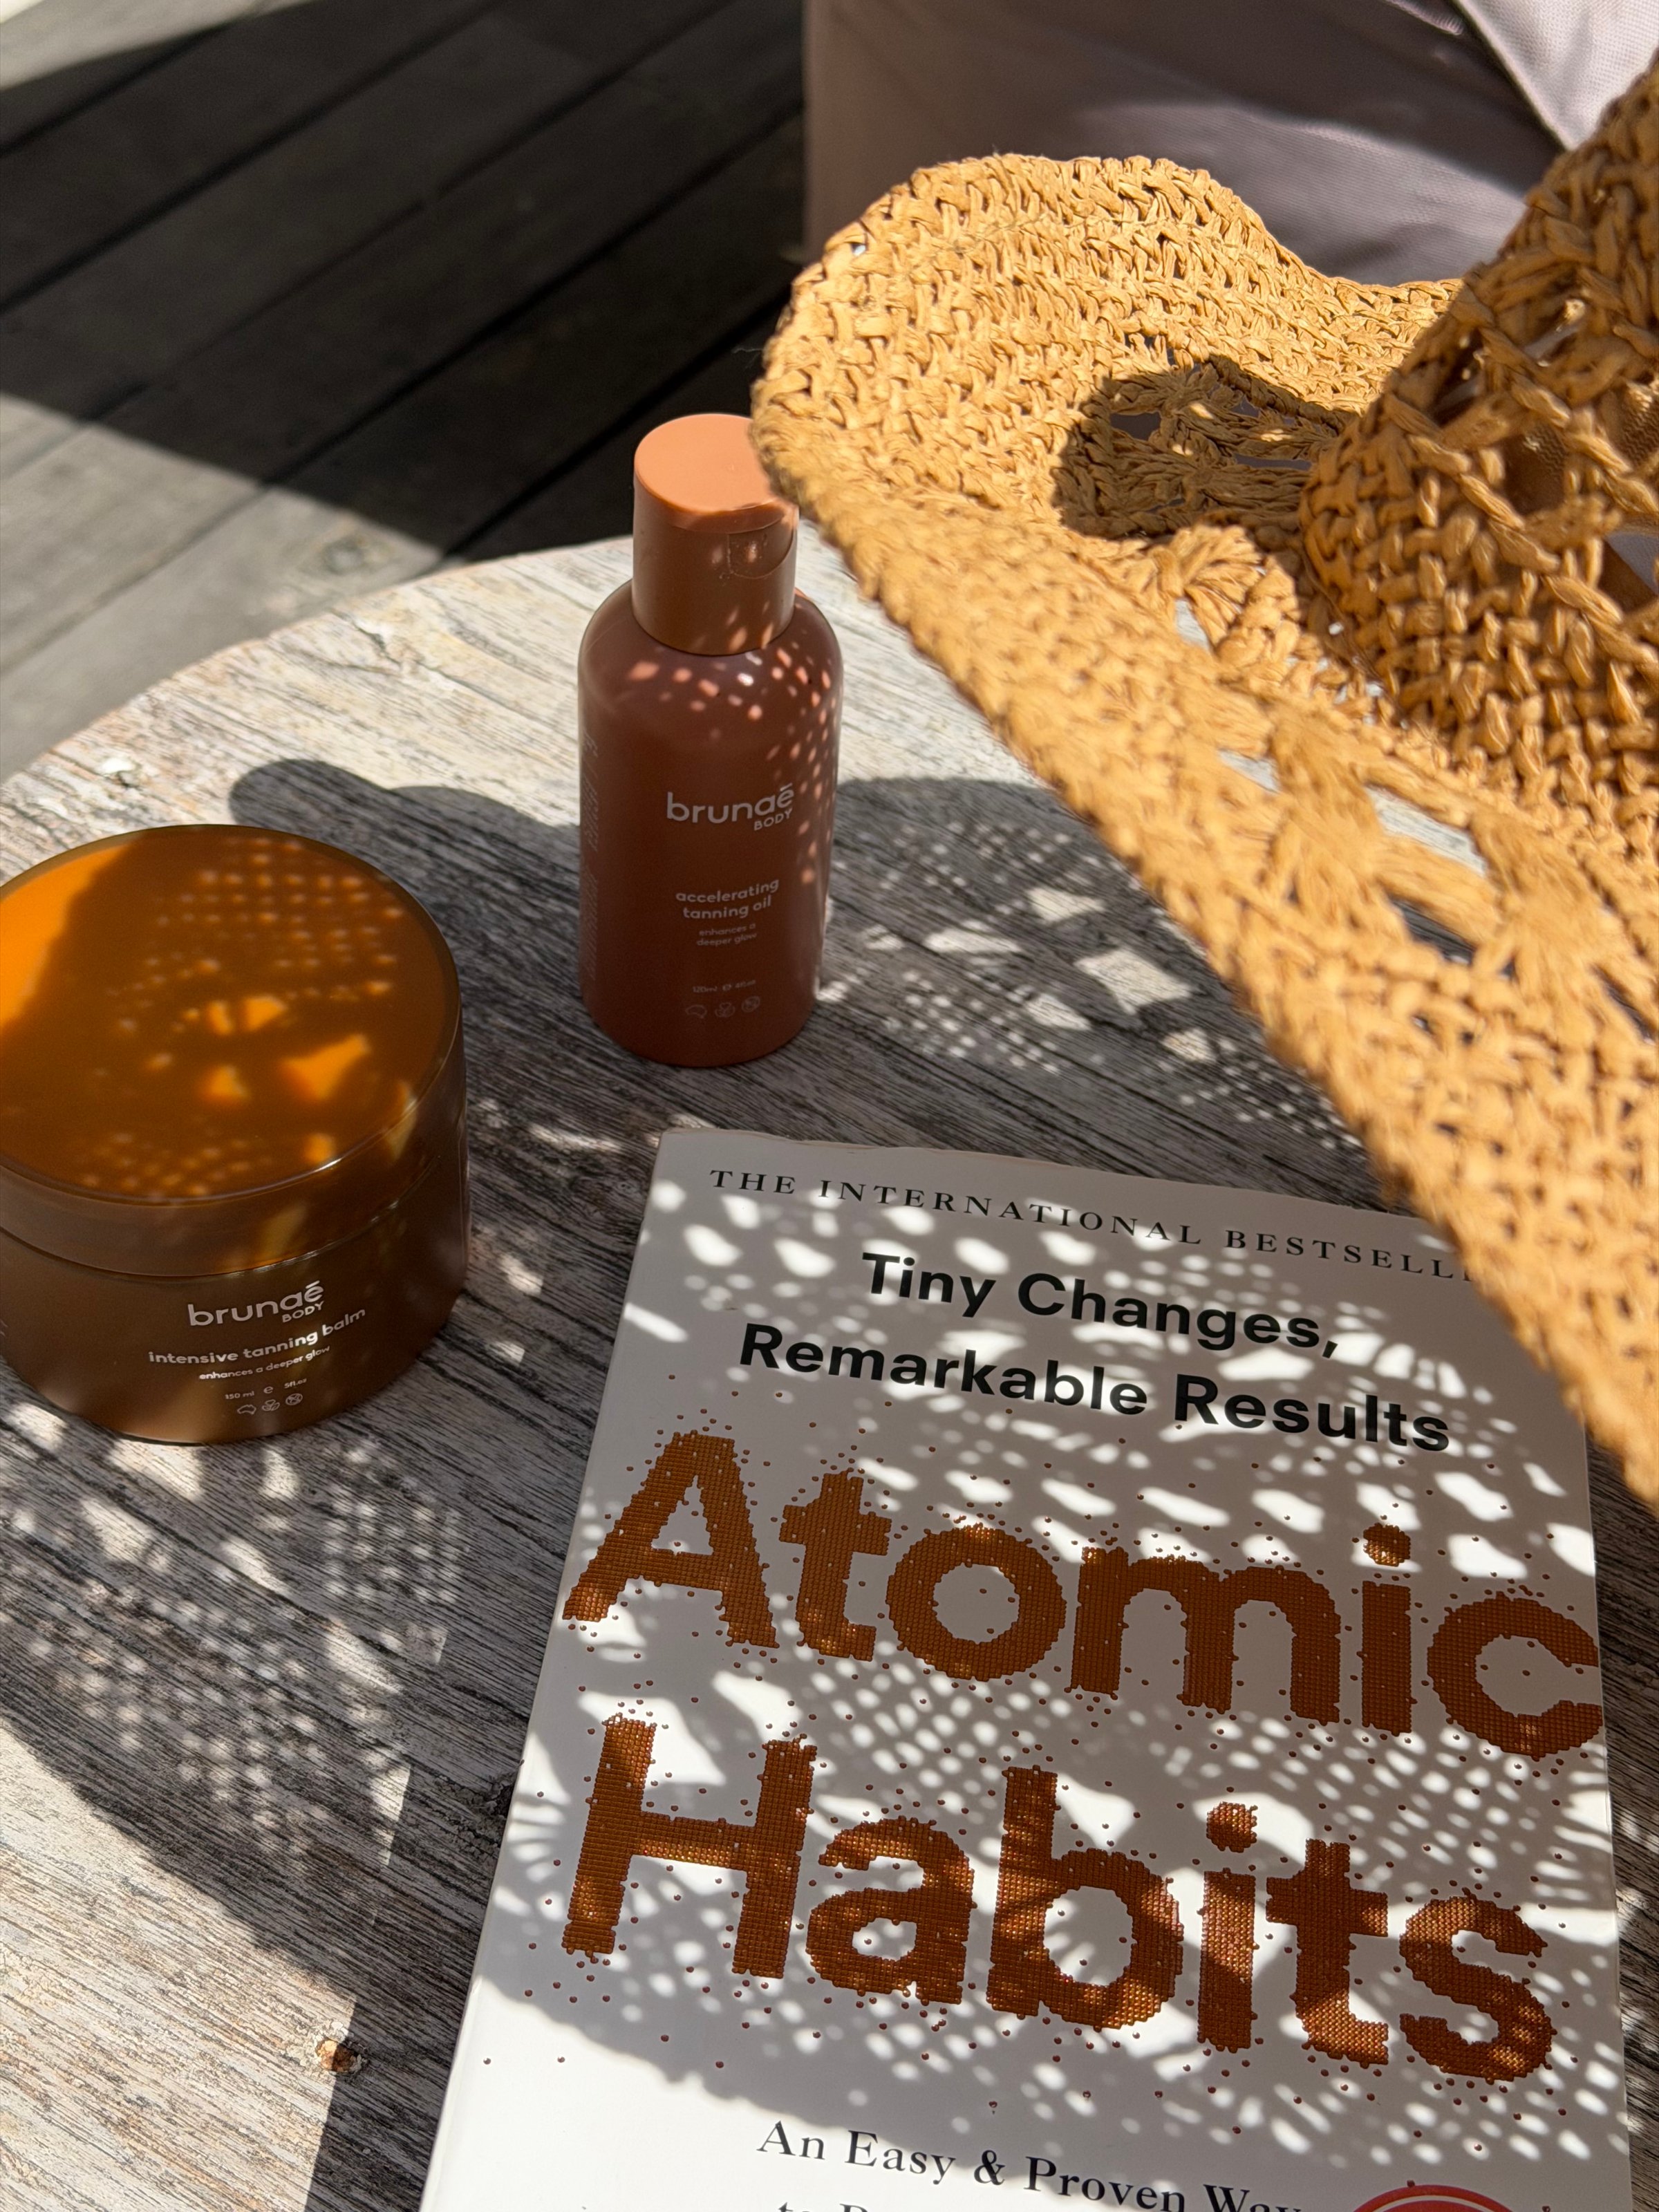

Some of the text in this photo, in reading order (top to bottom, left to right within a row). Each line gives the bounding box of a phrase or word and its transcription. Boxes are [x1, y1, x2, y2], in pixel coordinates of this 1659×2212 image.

[753, 808, 793, 831] BODY
[675, 879, 780, 903] accelerating
[683, 894, 771, 919] tanning oil
[697, 933, 757, 947] deeper glow
[699, 926, 747, 937] enhances
[710, 1170, 796, 1194] THE
[818, 1179, 1201, 1244] INTERNATIONAL
[282, 1300, 324, 1322] BODY
[862, 1252, 1338, 1359] Tiny Changes,
[149, 1309, 366, 1364] intensive tanning balm
[199, 1368, 253, 1380] enhances
[266, 1356, 303, 1371] deeper
[306, 1346, 330, 1362] glow
[740, 1323, 1450, 1452] Remarkable Results
[561, 1429, 1604, 1758] Atomic
[561, 1714, 1554, 2081] Habits
[756, 2120, 826, 2161] An
[845, 2130, 957, 2185] Easy
[973, 2150, 1006, 2186] &
[1023, 2156, 1186, 2212] Proven
